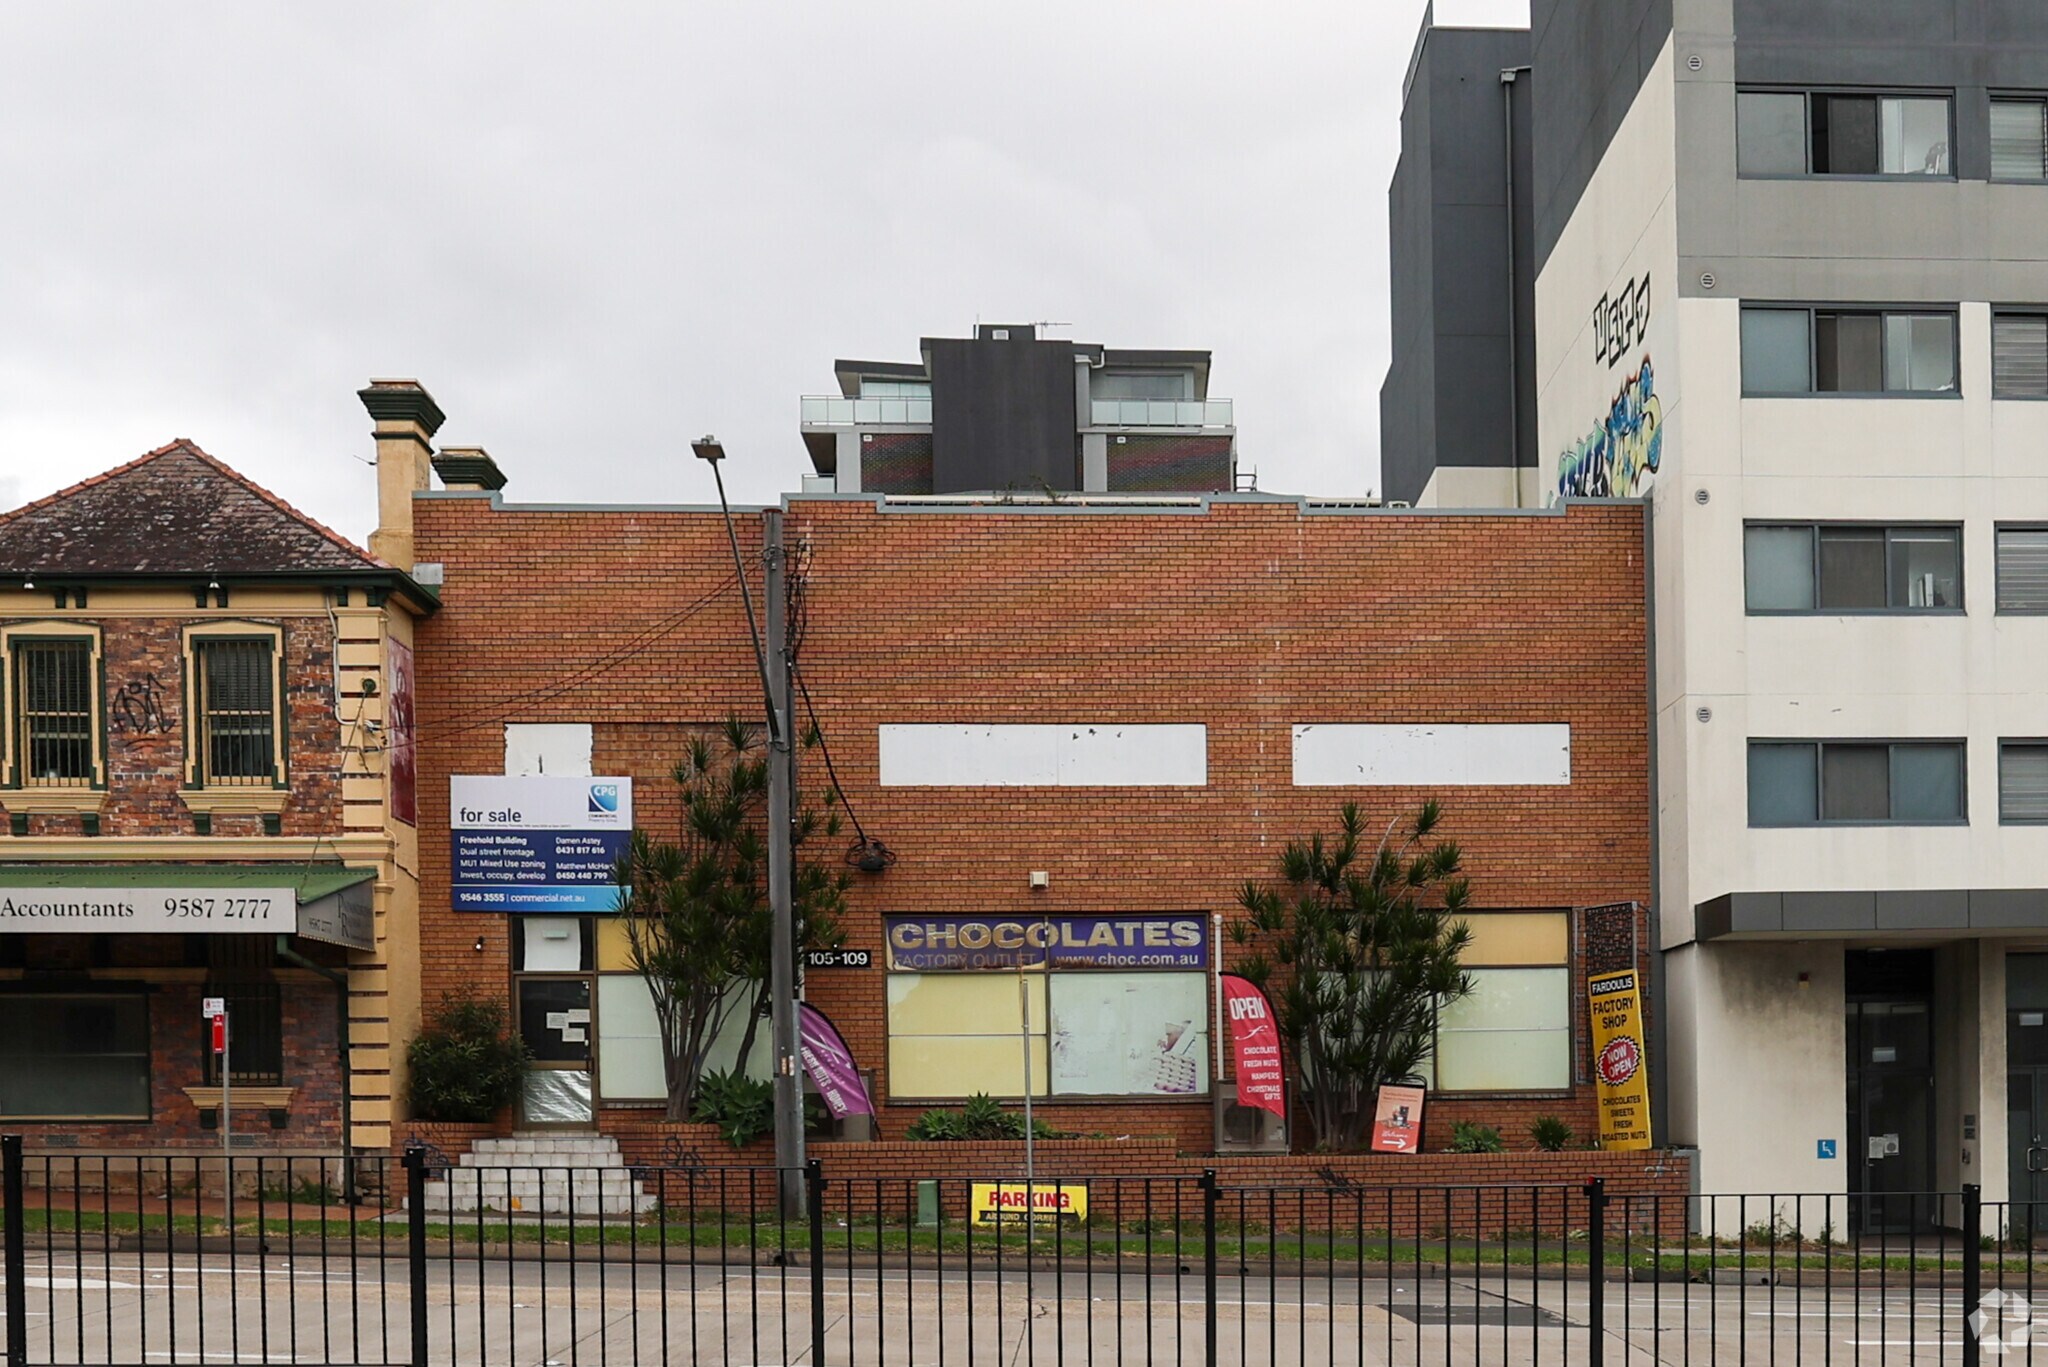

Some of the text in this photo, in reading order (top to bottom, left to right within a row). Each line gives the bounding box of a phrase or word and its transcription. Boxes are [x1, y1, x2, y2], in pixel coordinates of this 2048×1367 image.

[594, 786, 616, 797] CPG
[460, 807, 522, 822] for sale
[460, 836, 527, 846] Freehold Building
[460, 848, 535, 857] Dual street frontage
[555, 846, 606, 854] 0431 817 616
[504, 860, 519, 868] Use
[521, 861, 546, 869] zoning
[460, 871, 546, 880] Invest, occupy, develop
[555, 872, 576, 880] 0450
[460, 892, 585, 902] 9546 3555 commercial.net.au
[0, 897, 271, 919] Accountants 9587 2777
[891, 920, 1202, 949] CHOCOLATES
[809, 952, 868, 965] 105-109
[893, 952, 1036, 968] FACTORY OUTLET
[1056, 952, 1198, 967] www.choc.com.au
[1592, 977, 1633, 994] FARDOULIS
[1229, 996, 1265, 1020] OPEN
[1593, 997, 1634, 1015] FACTORY
[1602, 1014, 1627, 1029] SHOP
[1243, 1046, 1277, 1055] CHOCOLATE
[1607, 1044, 1627, 1064] NOW
[1609, 1057, 1633, 1078] OPEN
[1251, 1072, 1280, 1080] HAMPERS
[1247, 1085, 1280, 1093] CHRISTMAS
[1264, 1092, 1281, 1100] GIFTS
[1602, 1094, 1641, 1106] CHOCOLATES
[1610, 1107, 1635, 1117] SWEETS
[1613, 1120, 1633, 1129] FRESH
[1602, 1130, 1647, 1141] ROASTED NUTS
